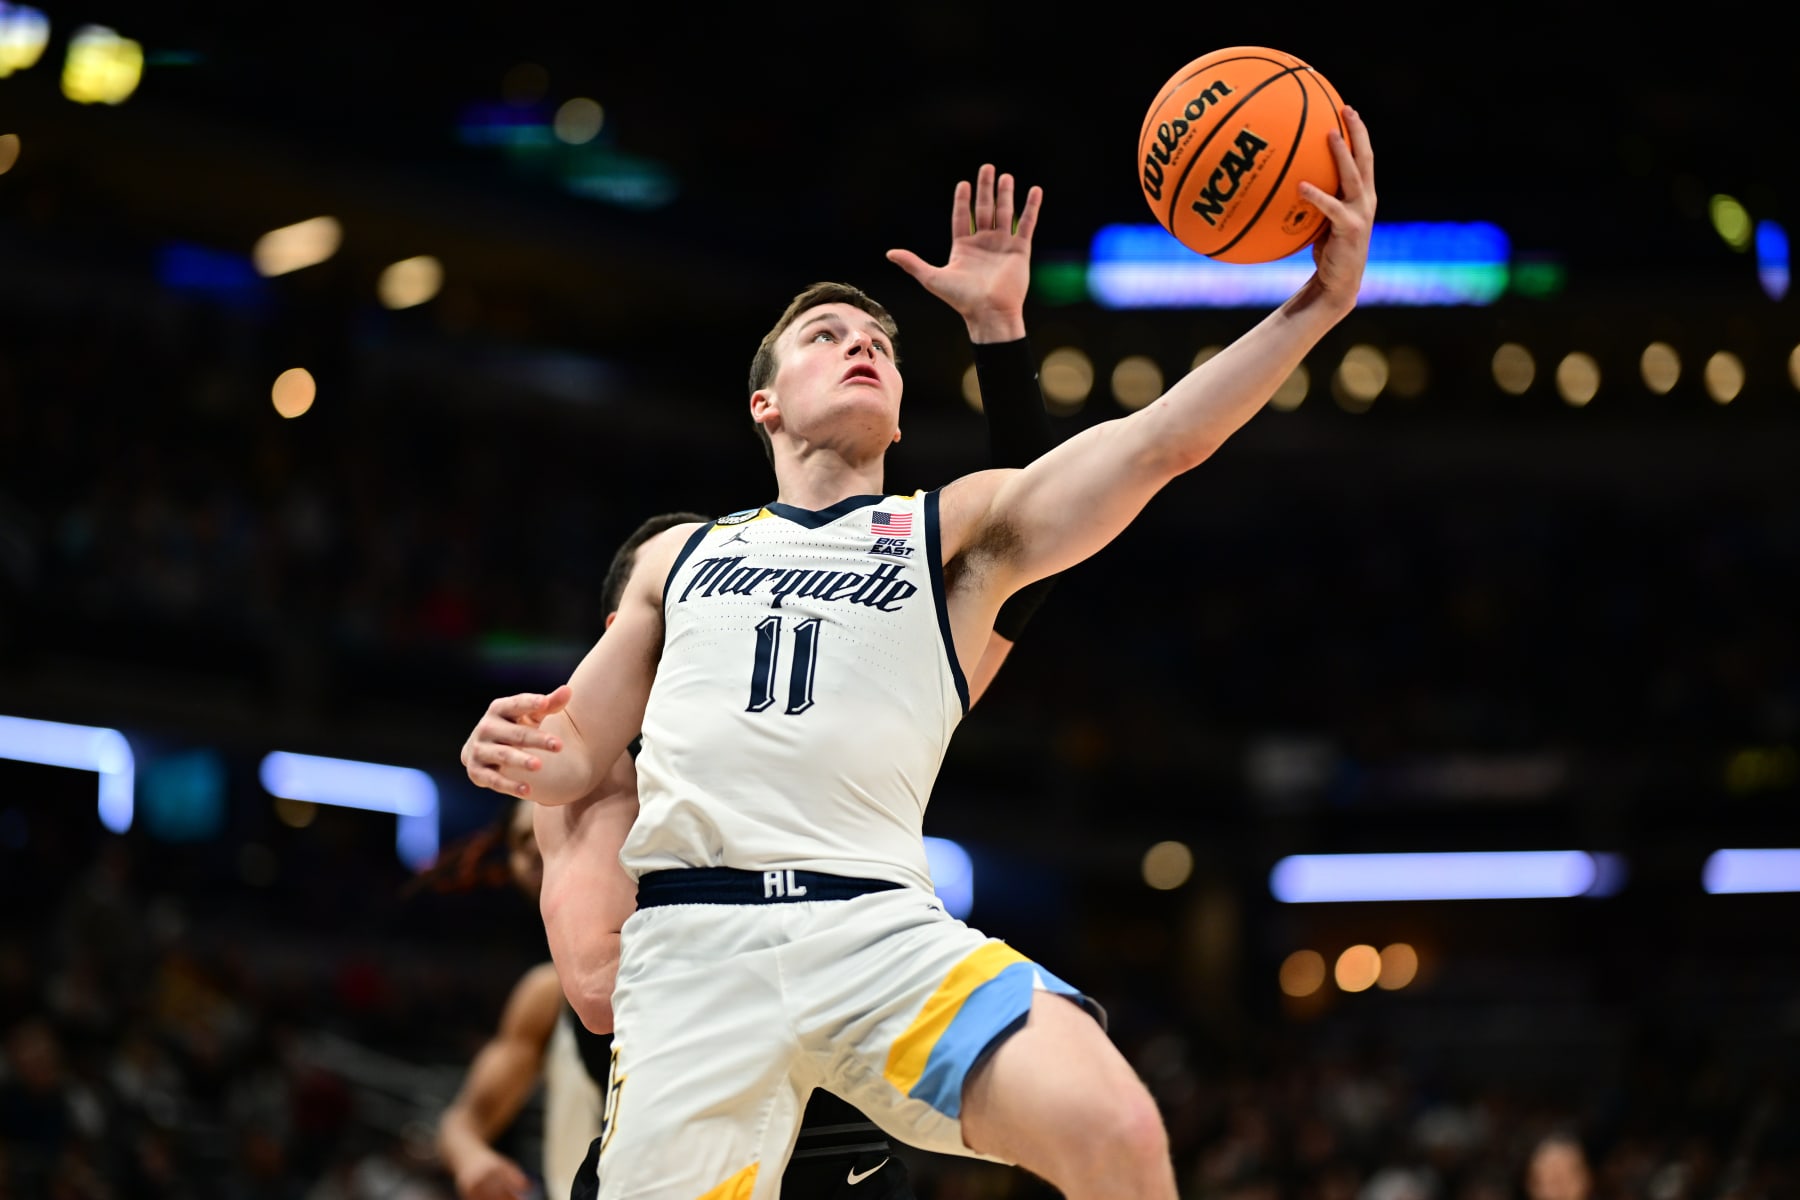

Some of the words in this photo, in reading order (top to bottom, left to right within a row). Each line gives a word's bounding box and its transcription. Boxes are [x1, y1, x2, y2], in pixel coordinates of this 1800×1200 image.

[1191, 128, 1268, 226] NCAA
[869, 544, 915, 557] EAST
[876, 537, 908, 547] BIG
[678, 556, 918, 613] Marquette
[744, 615, 822, 716] 11
[763, 870, 807, 898] AL
